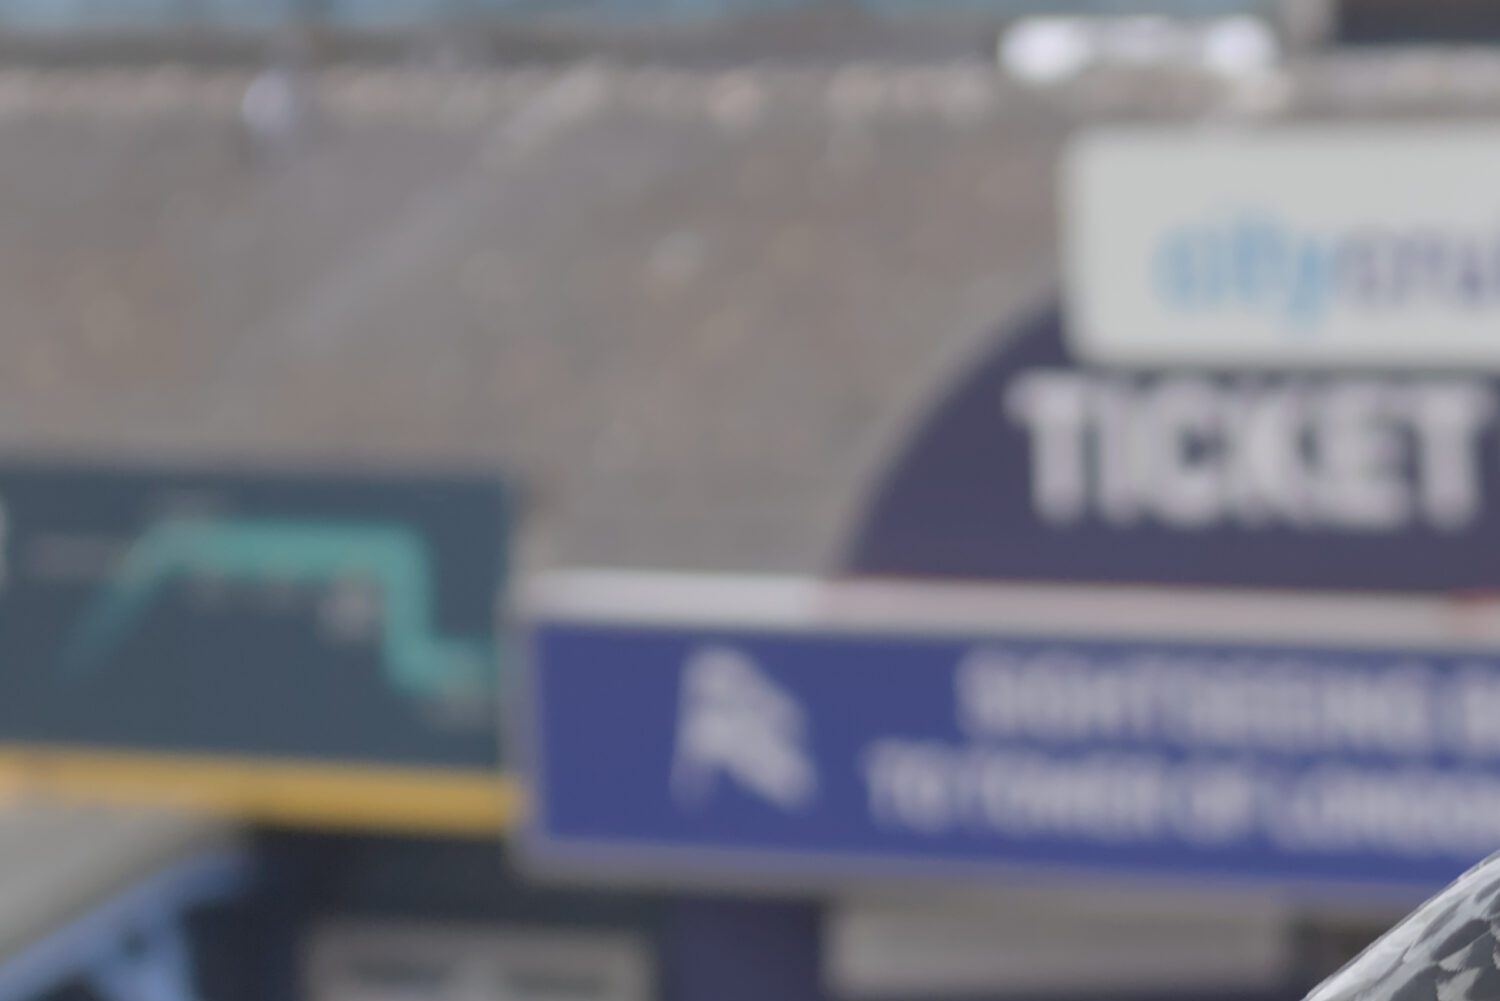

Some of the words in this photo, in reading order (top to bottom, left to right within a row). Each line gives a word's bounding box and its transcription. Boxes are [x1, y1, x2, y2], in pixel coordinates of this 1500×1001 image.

[1018, 374, 1484, 526] TICKET
[868, 740, 954, 832] TO
[976, 748, 1164, 841] TOWER
[1170, 758, 1254, 845] OF
